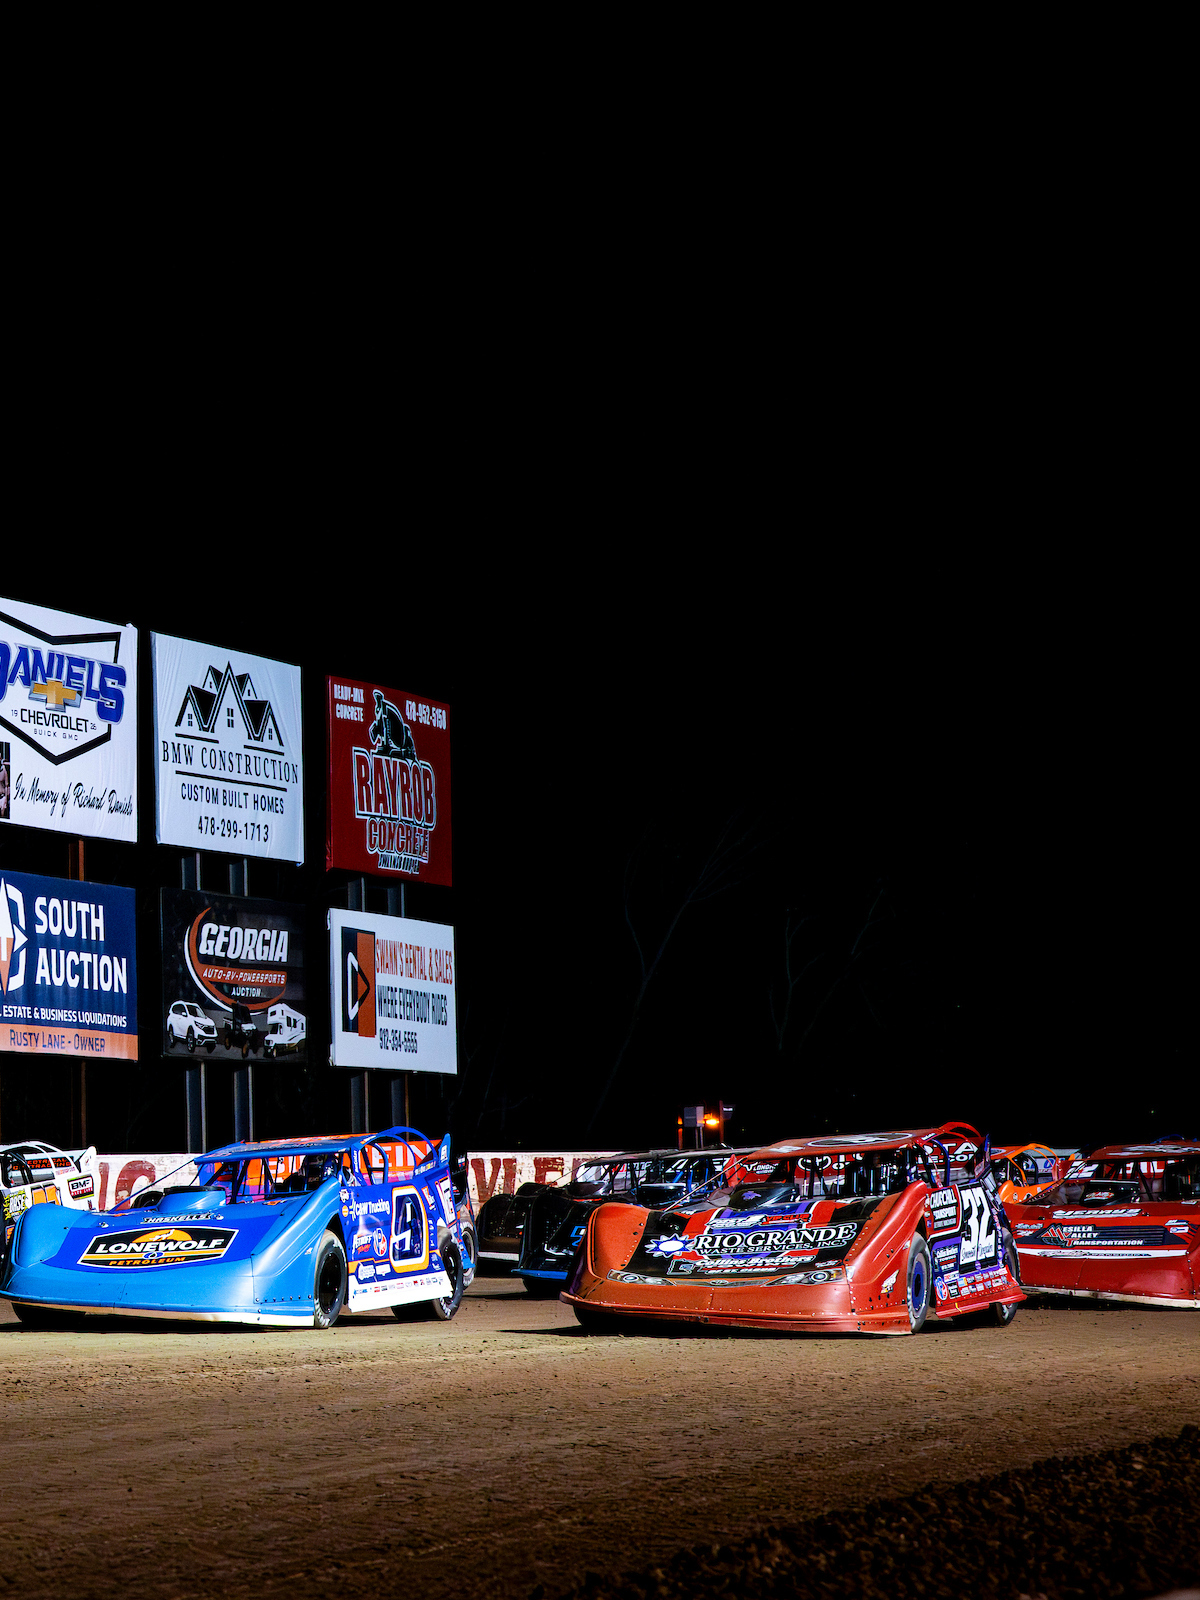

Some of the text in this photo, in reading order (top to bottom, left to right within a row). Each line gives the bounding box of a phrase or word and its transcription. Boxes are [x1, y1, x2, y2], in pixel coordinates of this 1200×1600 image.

[20, 708, 89, 733] CHEVROLET
[335, 703, 364, 722] CONCRETE
[33, 728, 79, 741] BUICK GMC
[162, 741, 298, 783] BMW CONSTRUCTION
[27, 776, 59, 816] Memory
[60, 782, 73, 817] of
[73, 782, 106, 810] Richard
[181, 783, 284, 814] CUSTOM BUILT HOMES
[352, 746, 436, 831] RAYROB
[198, 816, 269, 842] 478-299-1713
[35, 896, 104, 941] SOUTH
[199, 923, 288, 962] GEORGIA
[35, 947, 127, 994] AUCTION
[404, 943, 427, 980] RENTAL
[435, 948, 453, 985] SALES
[232, 987, 262, 997] AUCTION
[3, 1005, 31, 1018] ESTATE
[33, 1007, 40, 1019] &
[40, 1007, 77, 1022] BUSINESS
[78, 1011, 127, 1027] LIQUIDATIONS
[377, 985, 398, 1019] WHERE
[432, 992, 447, 1026] RIDES
[10, 1029, 39, 1047] RUSTY
[42, 1031, 65, 1049] LANE
[74, 1034, 105, 1052] OWNER
[369, 1199, 390, 1214] Trucking
[696, 1225, 854, 1250] RIO GRANDE
[960, 1187, 995, 1265] 32
[95, 1239, 224, 1254] LONEWOLF
[700, 1247, 744, 1255] WASTE
[818, 1240, 842, 1248] INC.
[109, 1257, 186, 1266] PETROLEUM
